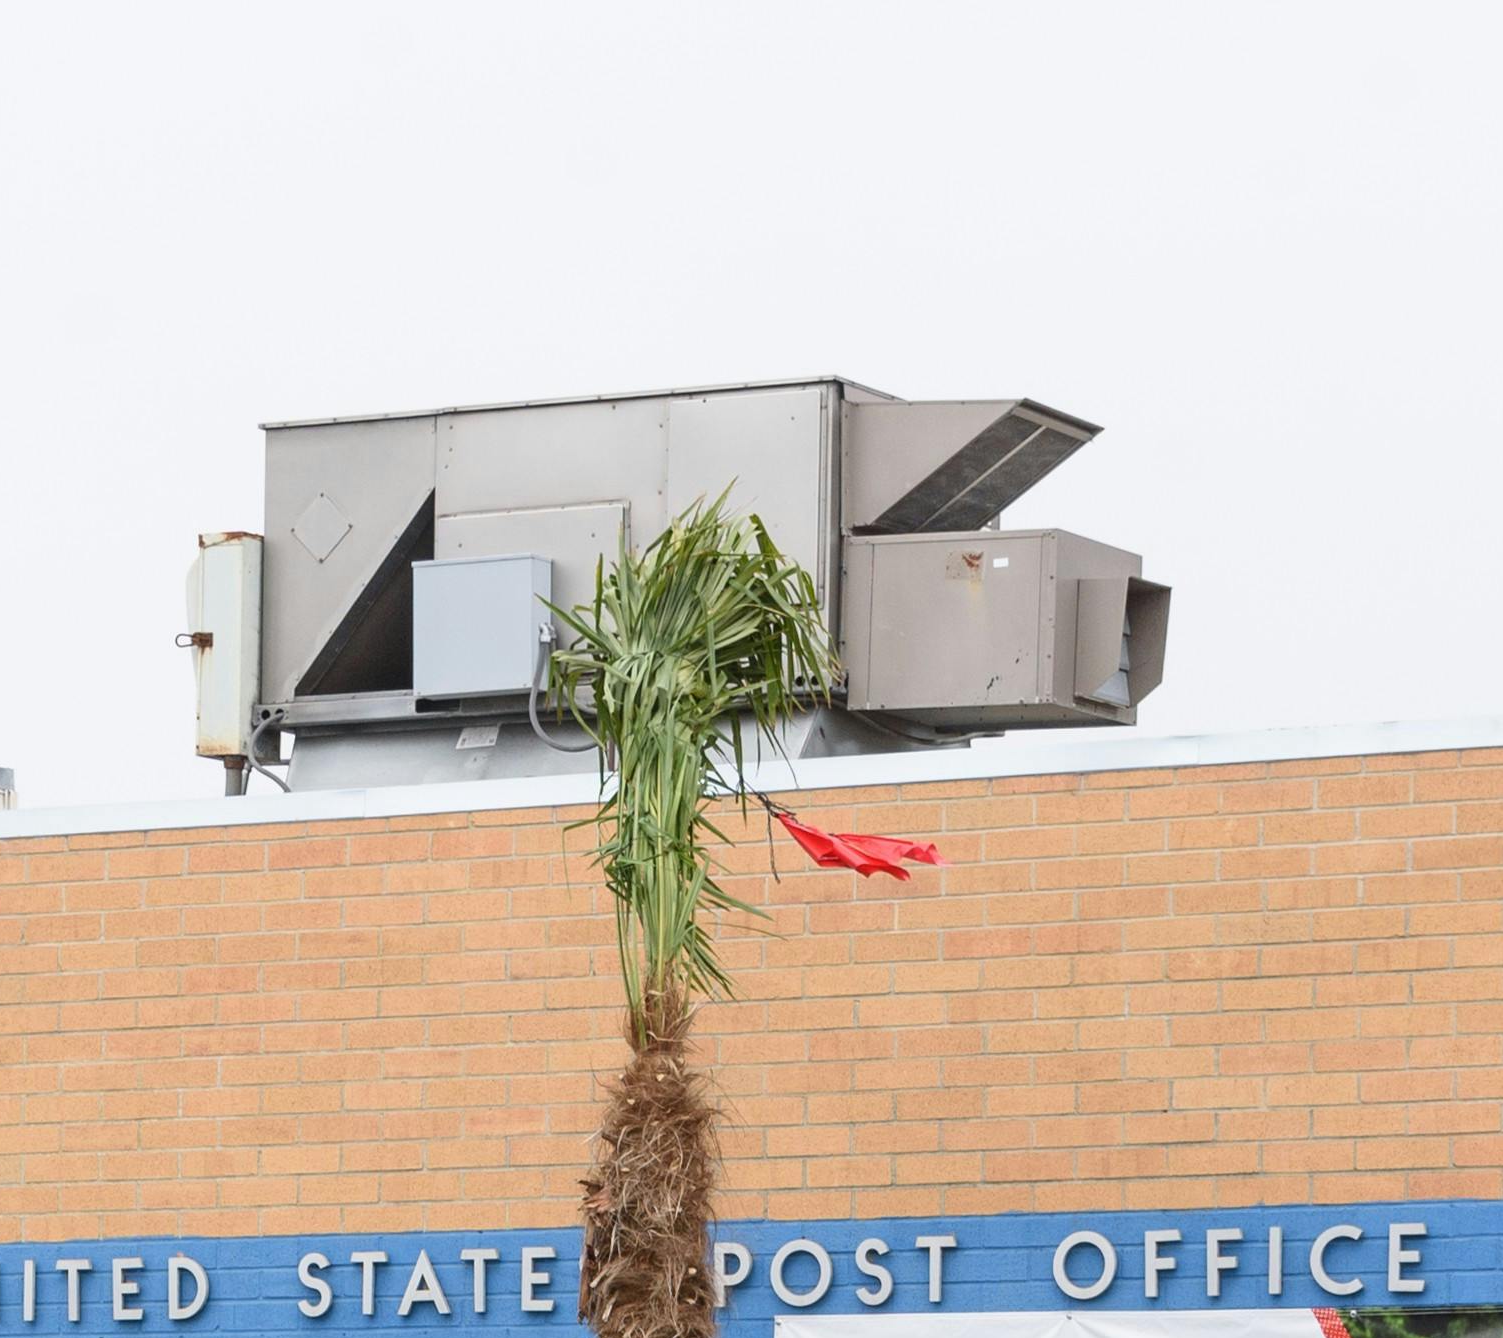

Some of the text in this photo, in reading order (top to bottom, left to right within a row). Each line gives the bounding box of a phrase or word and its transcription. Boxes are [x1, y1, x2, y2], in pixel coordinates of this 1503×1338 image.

[297, 1246, 557, 1317] STATE
[715, 1234, 957, 1307] POST
[1053, 1222, 1427, 1300] OFFICE
